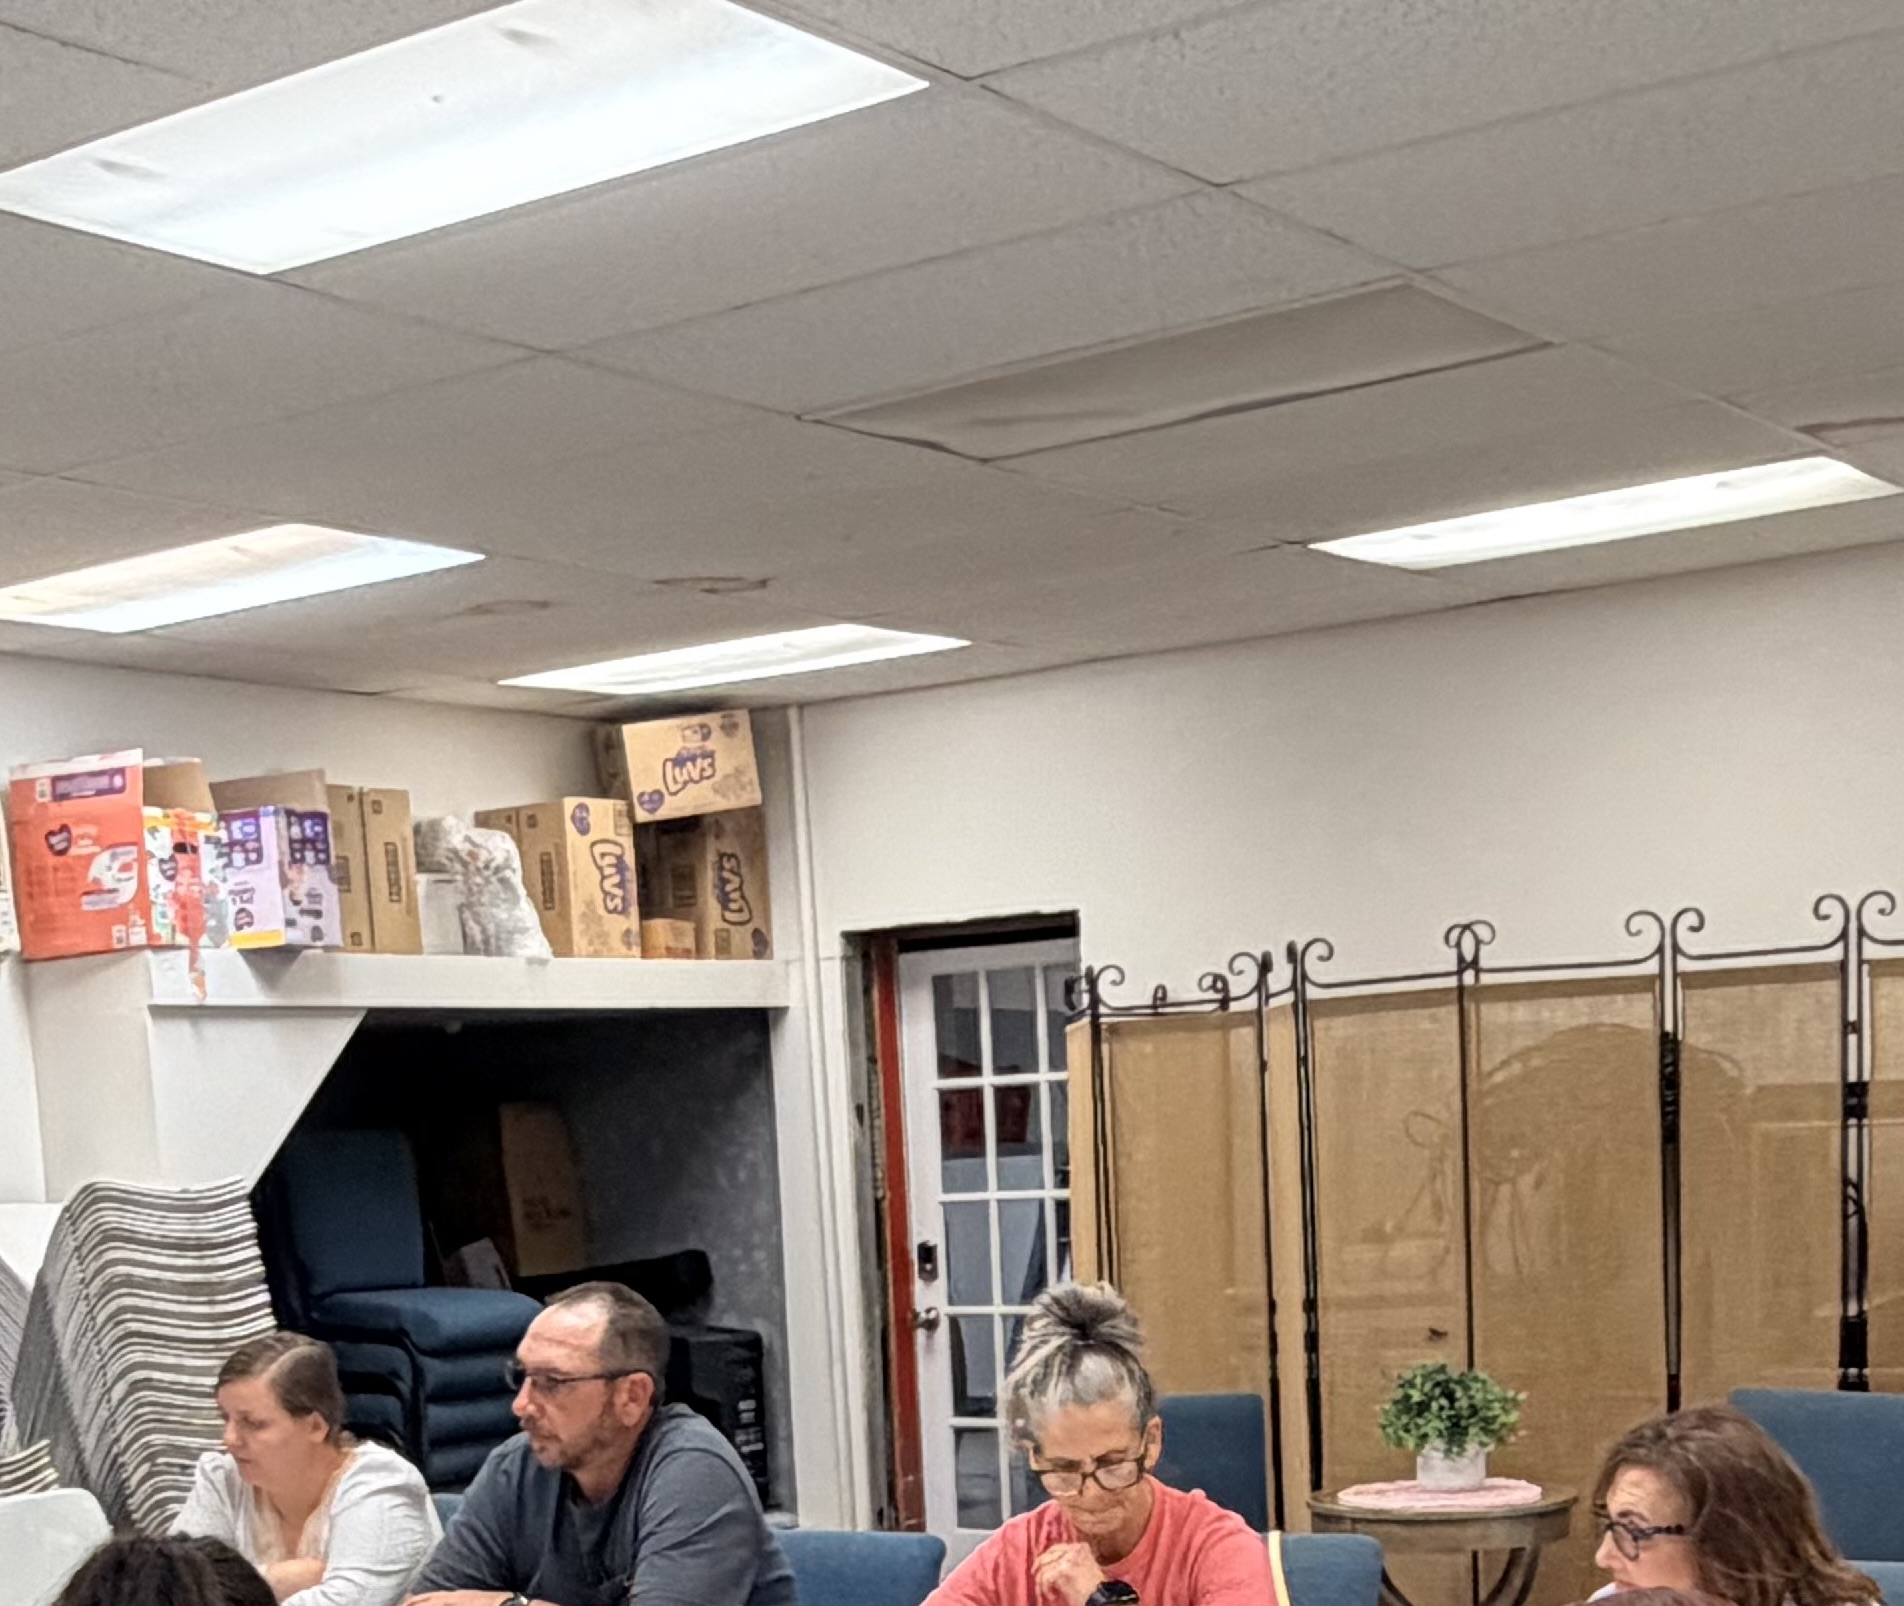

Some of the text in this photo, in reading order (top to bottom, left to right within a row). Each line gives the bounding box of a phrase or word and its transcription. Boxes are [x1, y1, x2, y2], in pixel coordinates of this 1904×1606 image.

[663, 756, 716, 796] Luvs
[590, 839, 625, 914] Luvs
[719, 852, 752, 925] Luvs
